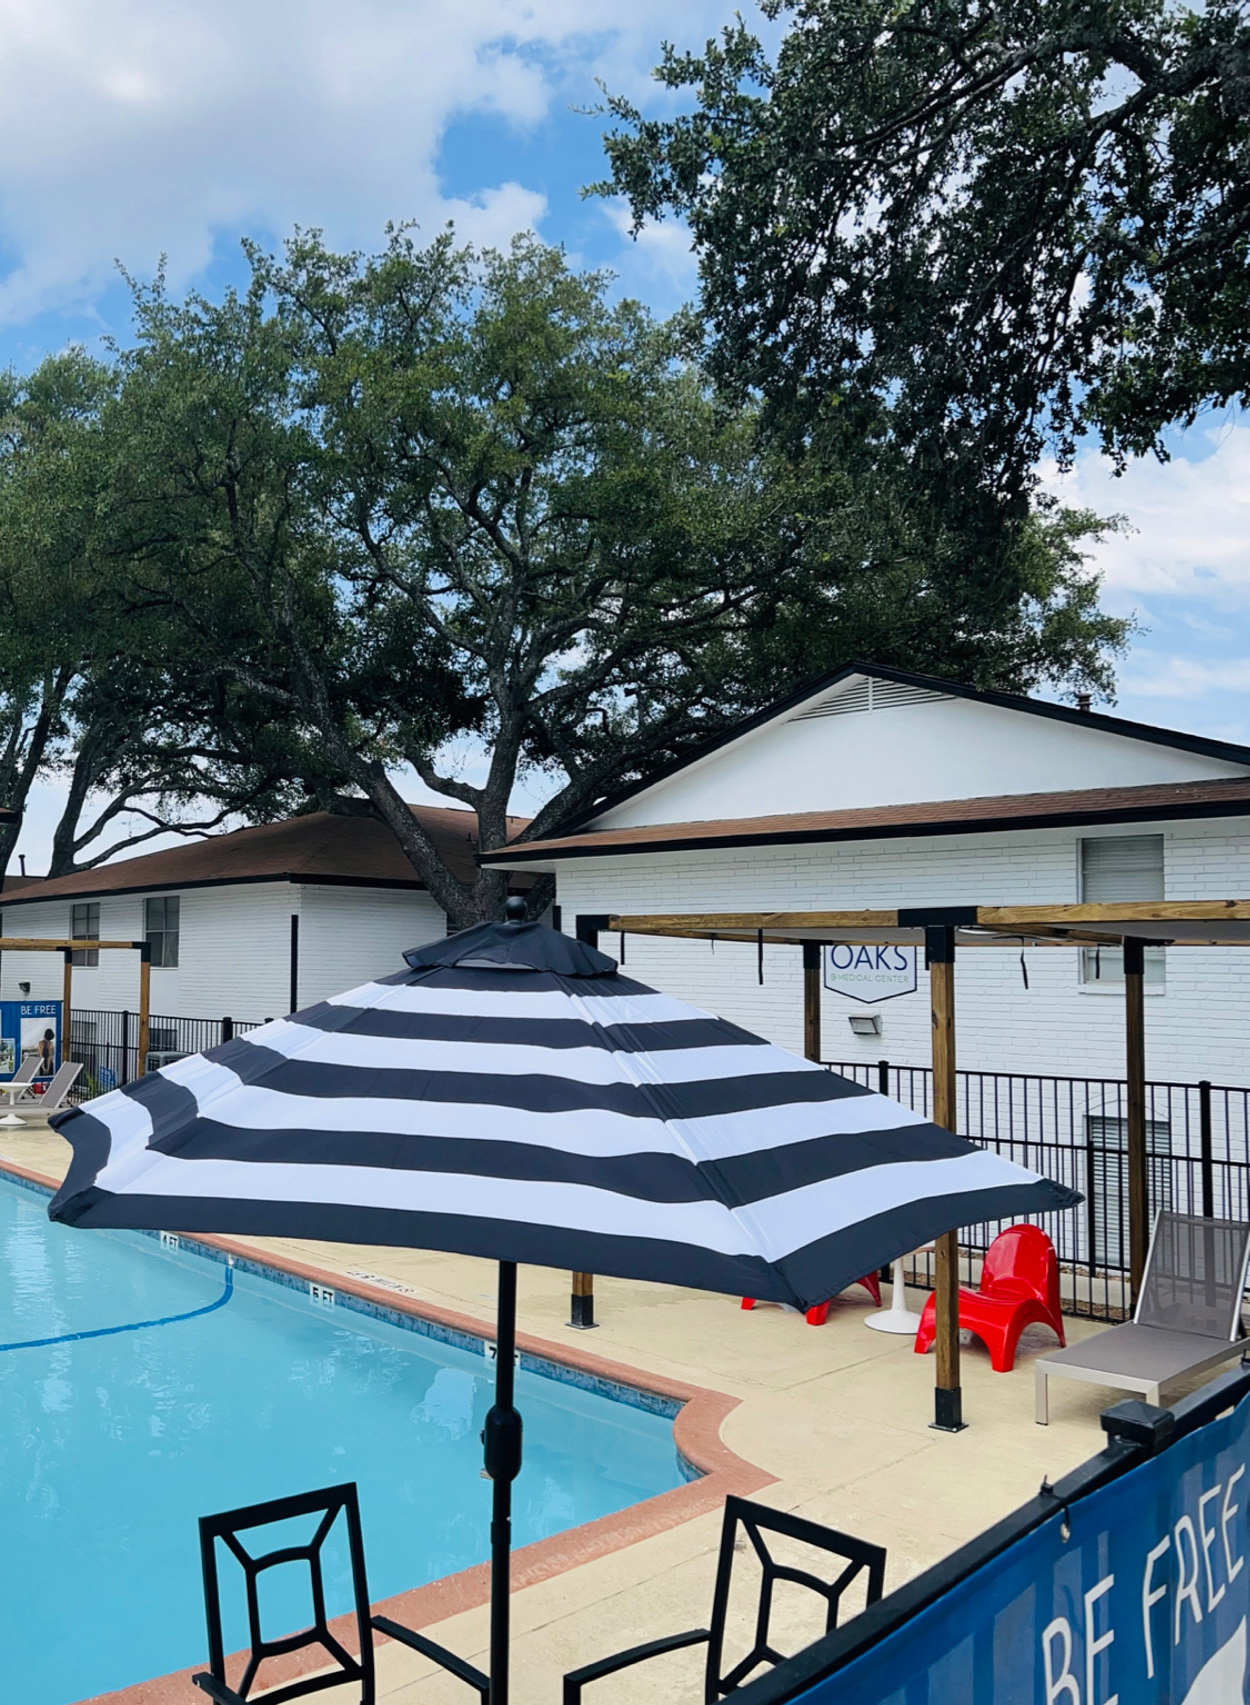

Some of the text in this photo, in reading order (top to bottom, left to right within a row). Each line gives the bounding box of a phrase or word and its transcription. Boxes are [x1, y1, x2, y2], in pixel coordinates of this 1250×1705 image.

[830, 945, 908, 971] OAKS
[875, 975, 909, 983] CENTER
[21, 1005, 57, 1015] BE FREE
[322, 1289, 334, 1305] FT
[1042, 1463, 1246, 1705] BE FREE
